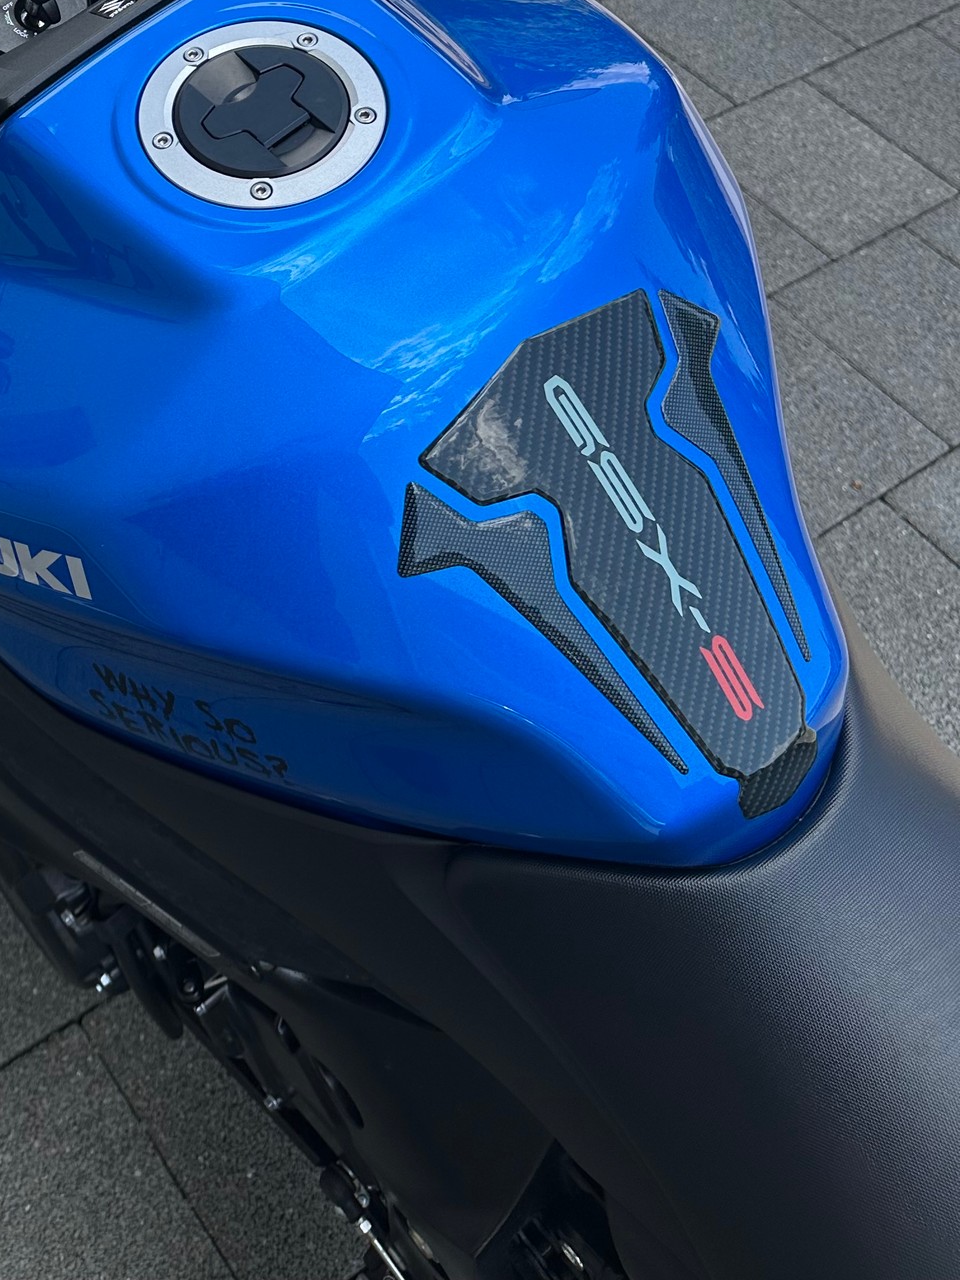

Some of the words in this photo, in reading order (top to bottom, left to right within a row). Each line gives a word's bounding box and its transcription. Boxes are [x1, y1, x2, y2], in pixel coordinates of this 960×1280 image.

[13, 27, 29, 39] LOCK
[543, 374, 765, 721] GSX-S
[89, 688, 296, 787] SERIOUS?
[92, 662, 175, 721] WHY
[194, 699, 257, 745] SO
